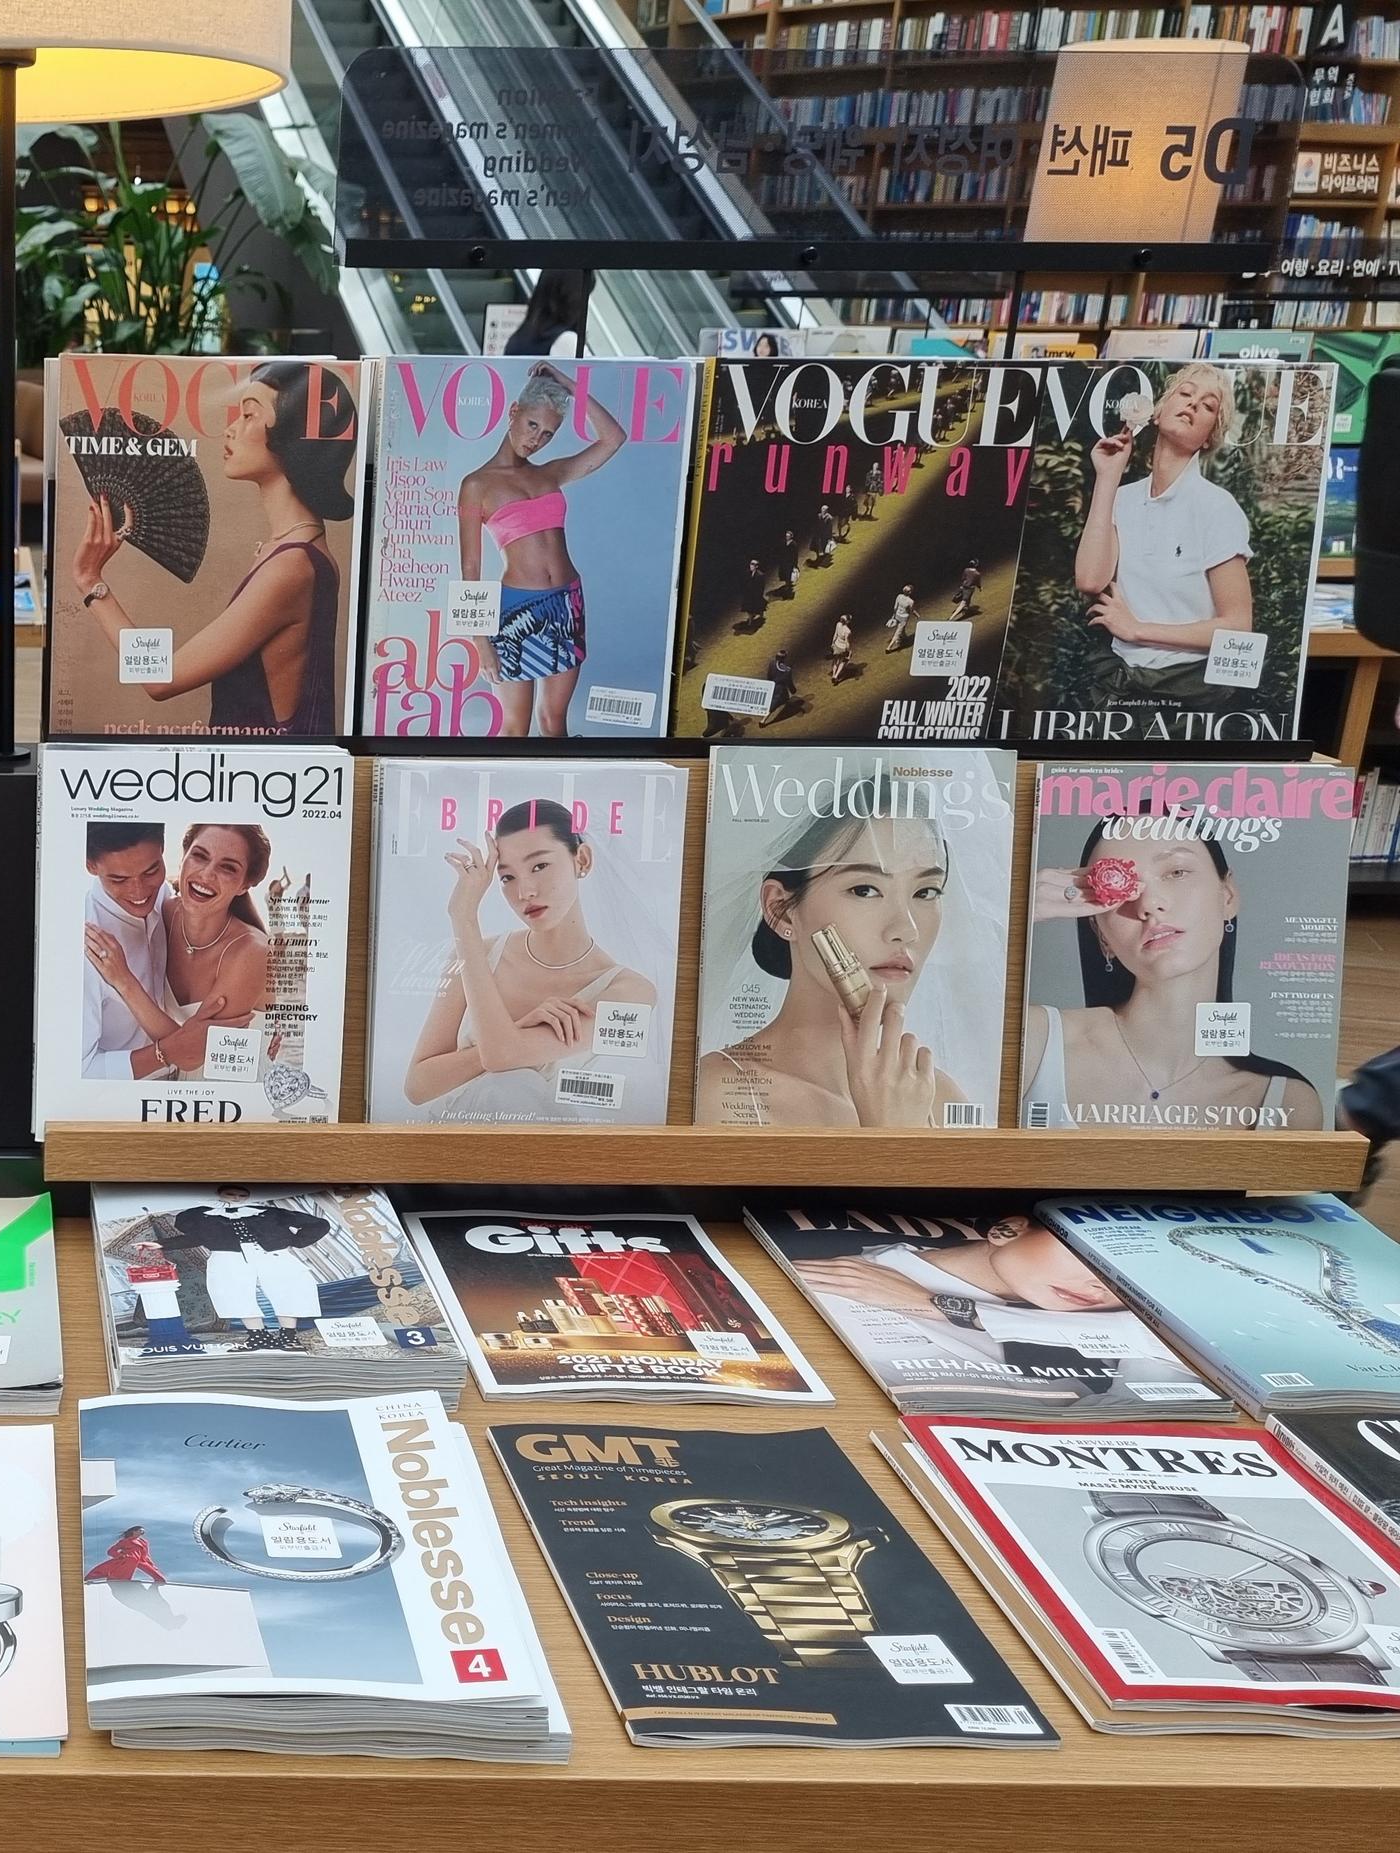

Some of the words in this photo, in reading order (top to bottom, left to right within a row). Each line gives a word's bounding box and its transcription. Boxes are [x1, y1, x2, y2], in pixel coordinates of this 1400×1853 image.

[1320, 4, 1344, 46] A
[1324, 153, 1379, 174] 비즈니스
[1321, 174, 1379, 194] 라이브러리
[1239, 345, 1280, 359] olive
[393, 361, 685, 444] VOUE
[721, 363, 1042, 448] VOGUE
[791, 398, 829, 409] KOREA
[1045, 365, 1328, 446] VOUE
[65, 436, 124, 457] TIME
[126, 438, 143, 457] &
[146, 438, 198, 458] GEM
[387, 456, 410, 472] Iris
[414, 457, 448, 472] Law
[384, 471, 426, 488] Jisoo
[707, 442, 1031, 506] runway
[385, 486, 420, 504] Yejin
[424, 487, 454, 501] Son
[383, 500, 429, 516] Maria
[382, 516, 431, 530] Chiuri
[384, 530, 454, 546] Junhwan
[381, 544, 411, 559] Cha
[380, 559, 449, 574] Daeheon
[380, 573, 436, 592] Hwang
[378, 588, 422, 602] Ateez
[451, 608, 496, 619] 열람용도서
[376, 610, 481, 693] ab
[946, 675, 992, 702] 2022
[374, 663, 504, 737] fab
[880, 700, 987, 727] FALL/WINTER
[893, 765, 953, 779] Noblesse
[60, 752, 343, 818] wedding21
[1041, 764, 1200, 818] marie
[1205, 762, 1358, 820] claire
[720, 757, 1012, 831] Weddings
[302, 808, 342, 820] 2022.04
[440, 798, 625, 835] BRIDE
[1101, 803, 1282, 853] weddings
[267, 938, 320, 946] CELEBRITY
[741, 984, 760, 994] 045
[265, 1003, 309, 1012] WEDDING
[265, 1013, 318, 1021] DIRECTORY
[1200, 1028, 1245, 1039] 열람용도서
[210, 1052, 255, 1065] 열람용도서
[140, 1099, 242, 1122] FRED
[458, 1111, 493, 1122] Getting
[492, 1112, 536, 1121] Married!
[1059, 1103, 1200, 1127] MARRIAGE
[1204, 1106, 1295, 1128] STORY
[1067, 1204, 1359, 1228] NEIGHBOR
[785, 1208, 992, 1242] LADY
[464, 1224, 671, 1255] Gifts
[407, 1331, 426, 1346] 3
[557, 1354, 613, 1365] 2021
[618, 1355, 724, 1369] HOLIDAY
[891, 1358, 1021, 1376] RICHARD
[1029, 1366, 1124, 1379] MILLE
[572, 1363, 645, 1375] GIFTS
[648, 1365, 721, 1378] BOOK
[375, 1402, 422, 1412] CHINA
[378, 1410, 425, 1420] KOREA
[183, 1433, 268, 1453] Cartier
[515, 1433, 680, 1466] GMT
[1057, 1438, 1072, 1446] LA
[1074, 1439, 1114, 1447] REVUE
[1117, 1440, 1138, 1448] DES
[949, 1436, 1279, 1480] MONTRES
[564, 1464, 614, 1473] Magazine
[629, 1467, 687, 1476] Timepieces
[624, 1476, 693, 1485] KOREA
[1077, 1481, 1113, 1490] MASSE
[1114, 1482, 1200, 1493] MYSTÉRIEUSE
[1107, 1477, 1158, 1486] CARTIER
[380, 1419, 485, 1647] Noblesse
[585, 1571, 639, 1579] Close-up
[607, 1615, 651, 1624] Design
[467, 1653, 492, 1679] 4
[889, 1656, 954, 1669] 열람용도서
[631, 1663, 780, 1685] HUBLOT
